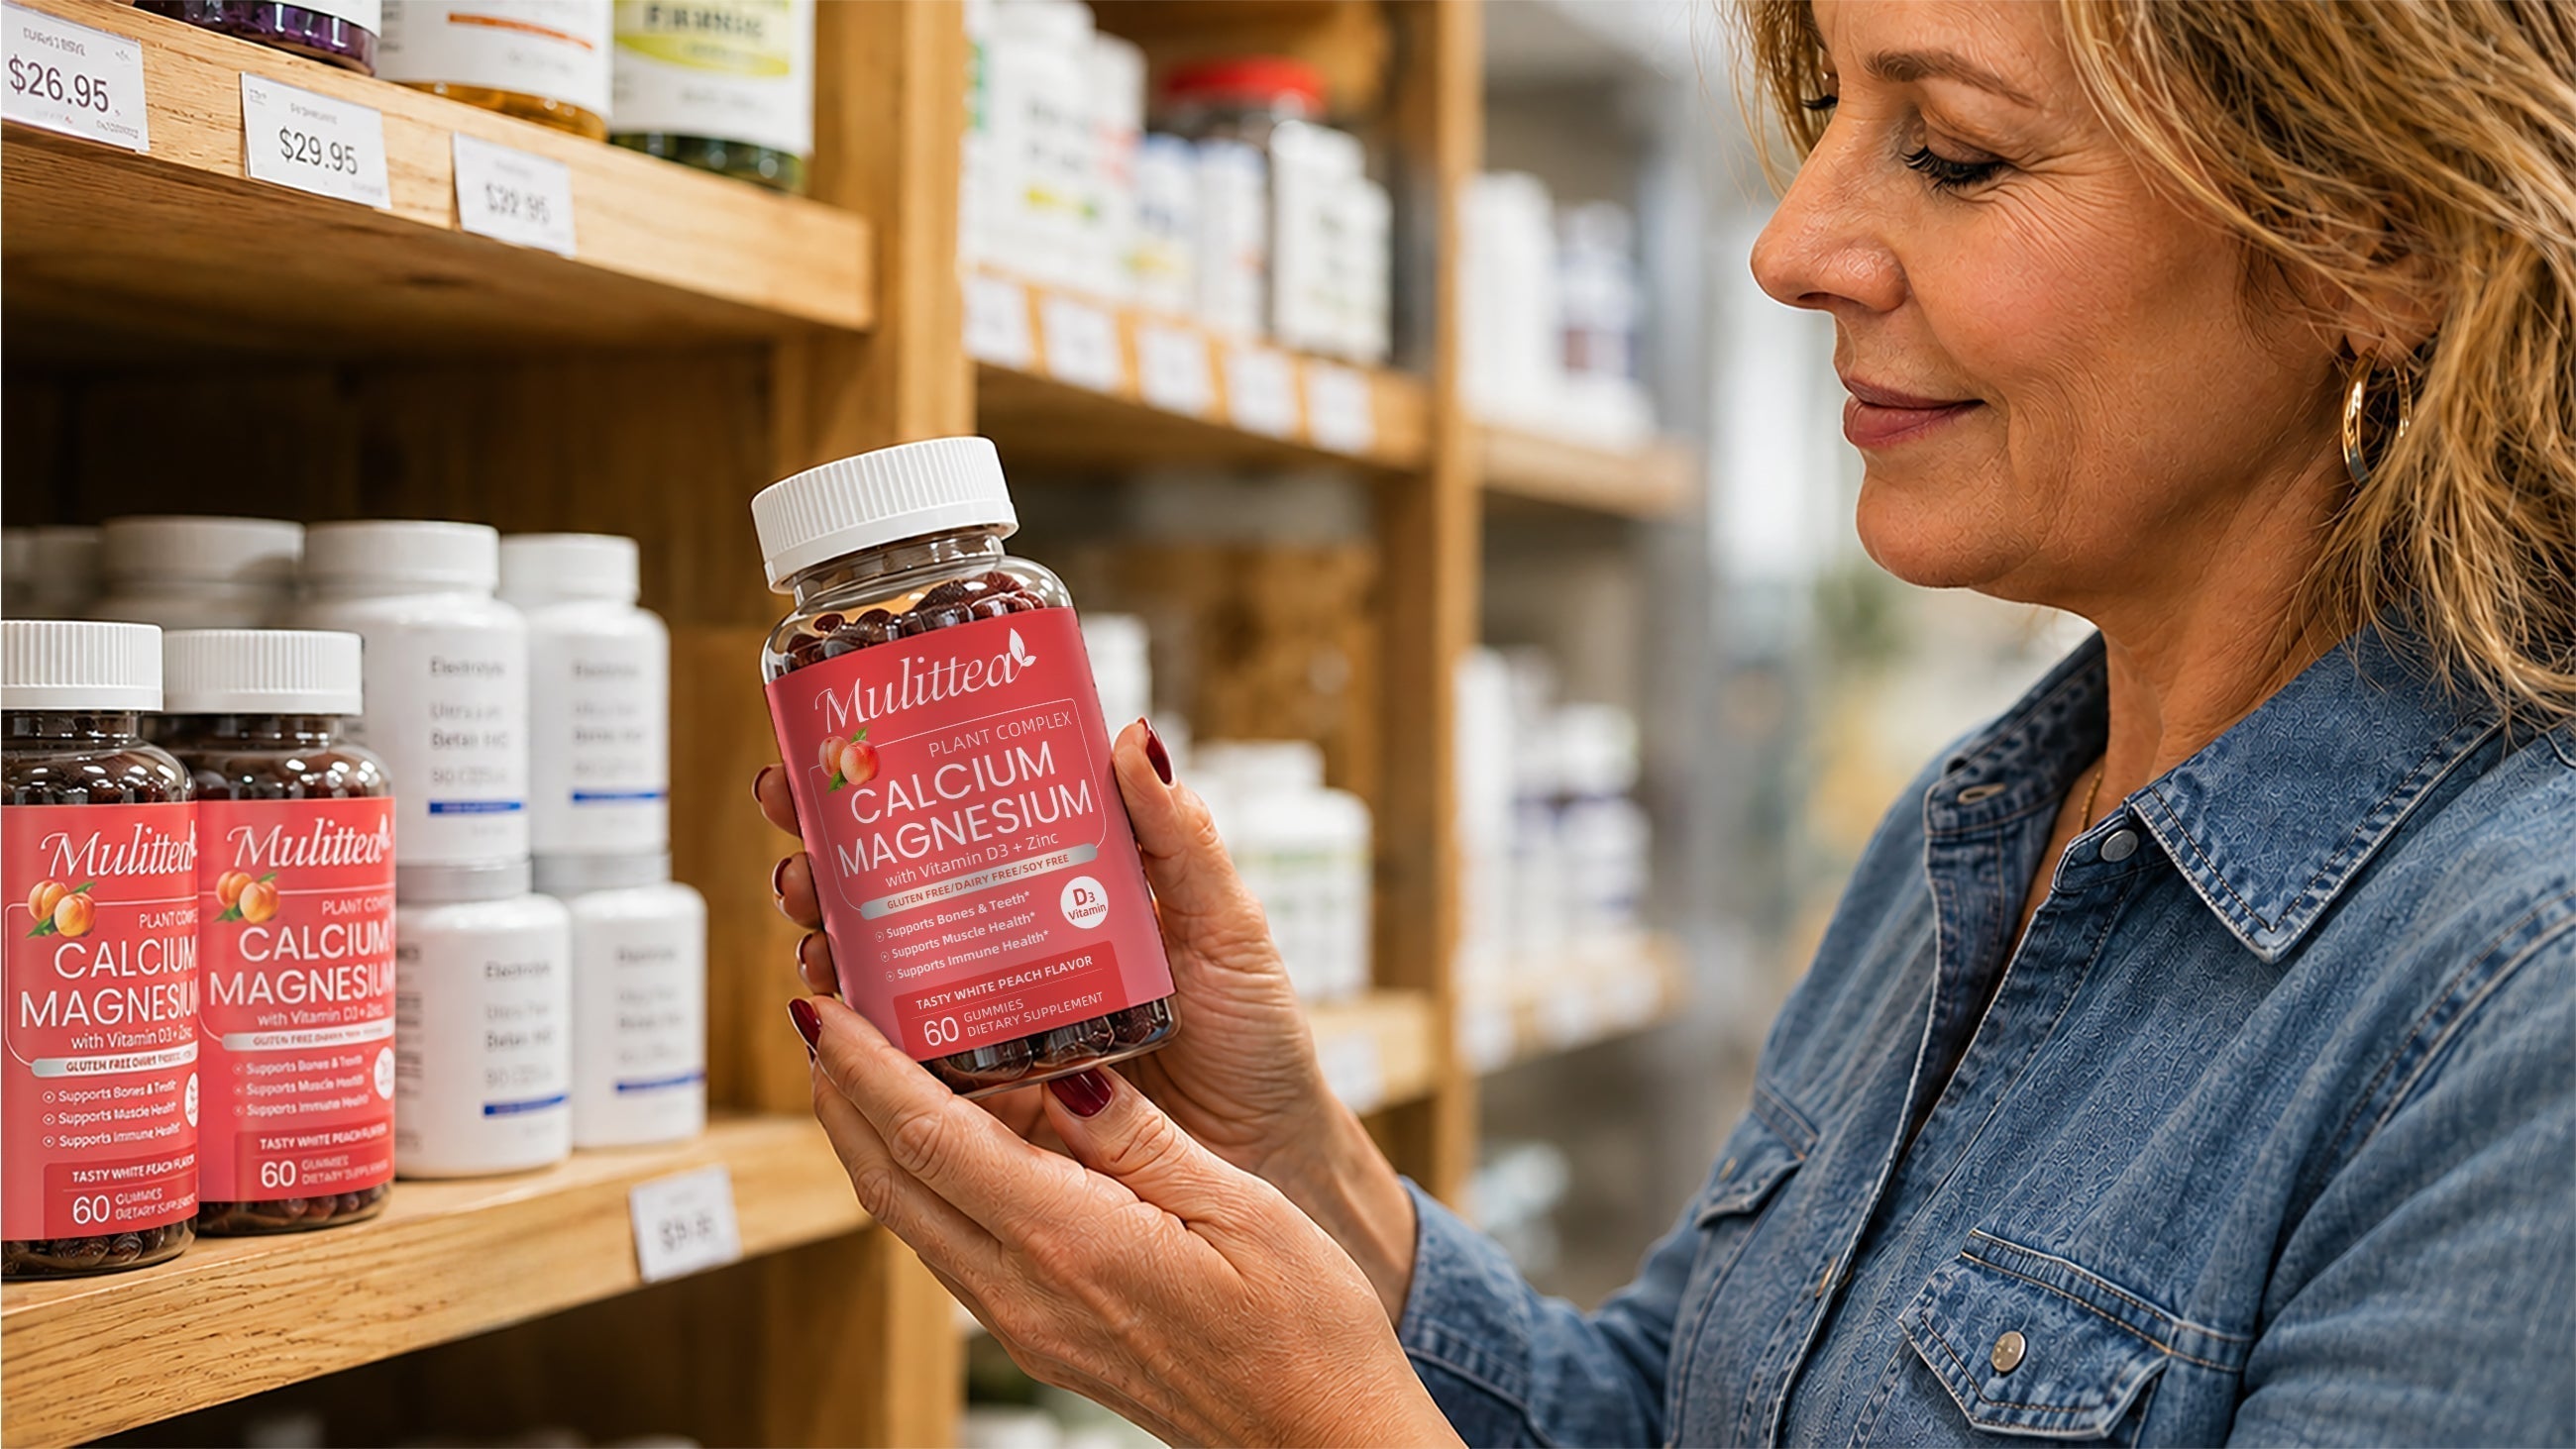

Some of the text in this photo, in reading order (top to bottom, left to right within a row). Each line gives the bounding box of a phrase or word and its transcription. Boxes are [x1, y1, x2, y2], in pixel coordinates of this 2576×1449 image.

[9, 53, 109, 113] $26.95
[278, 125, 358, 175] $29.95
[814, 650, 1022, 734] Mulittea
[928, 710, 1073, 758] PLANT COMPLEX
[850, 740, 1056, 824] CALCIUM
[837, 778, 1094, 879] MAGNESIUM
[885, 832, 1059, 888] with Vitamin D3 + Zinc
[887, 854, 1069, 910] GLUTEN FREE/DAIRY FREE/SOY FREE
[139, 910, 175, 929] PLANT
[886, 917, 935, 940] Supports
[936, 907, 976, 925] Bones
[978, 903, 988, 914] &
[1067, 901, 1107, 922] Vitamin
[239, 920, 390, 963] CALCIUM
[892, 937, 940, 962] Supports
[942, 926, 986, 946] Muscle
[54, 936, 197, 979] CALCIUM
[897, 957, 946, 982] Supports
[947, 944, 1000, 967] Immune
[915, 955, 1093, 1011] TASTY WHITE PEACH FLAVOR
[258, 1012, 288, 1027] with
[290, 1008, 341, 1025] Vitamin
[963, 998, 1024, 1024] GUMMIES
[967, 991, 1104, 1038] DIETARY SUPPLEMENT
[71, 1032, 104, 1050] with
[107, 1030, 158, 1049] Vitamin
[923, 1016, 960, 1047] 60
[246, 1061, 296, 1076] Supports
[58, 1088, 111, 1104] Supports
[246, 1082, 296, 1096] Supports
[58, 1110, 111, 1126] Supports
[246, 1101, 296, 1116] Supports
[58, 1132, 111, 1148] Supports
[113, 1128, 155, 1142] Immune
[260, 1137, 295, 1150] TASTY
[297, 1133, 331, 1148] WHITE
[72, 1170, 110, 1183] TASTY
[112, 1165, 146, 1180] WHITE
[261, 1160, 296, 1188] 60
[72, 1194, 111, 1224] 60
